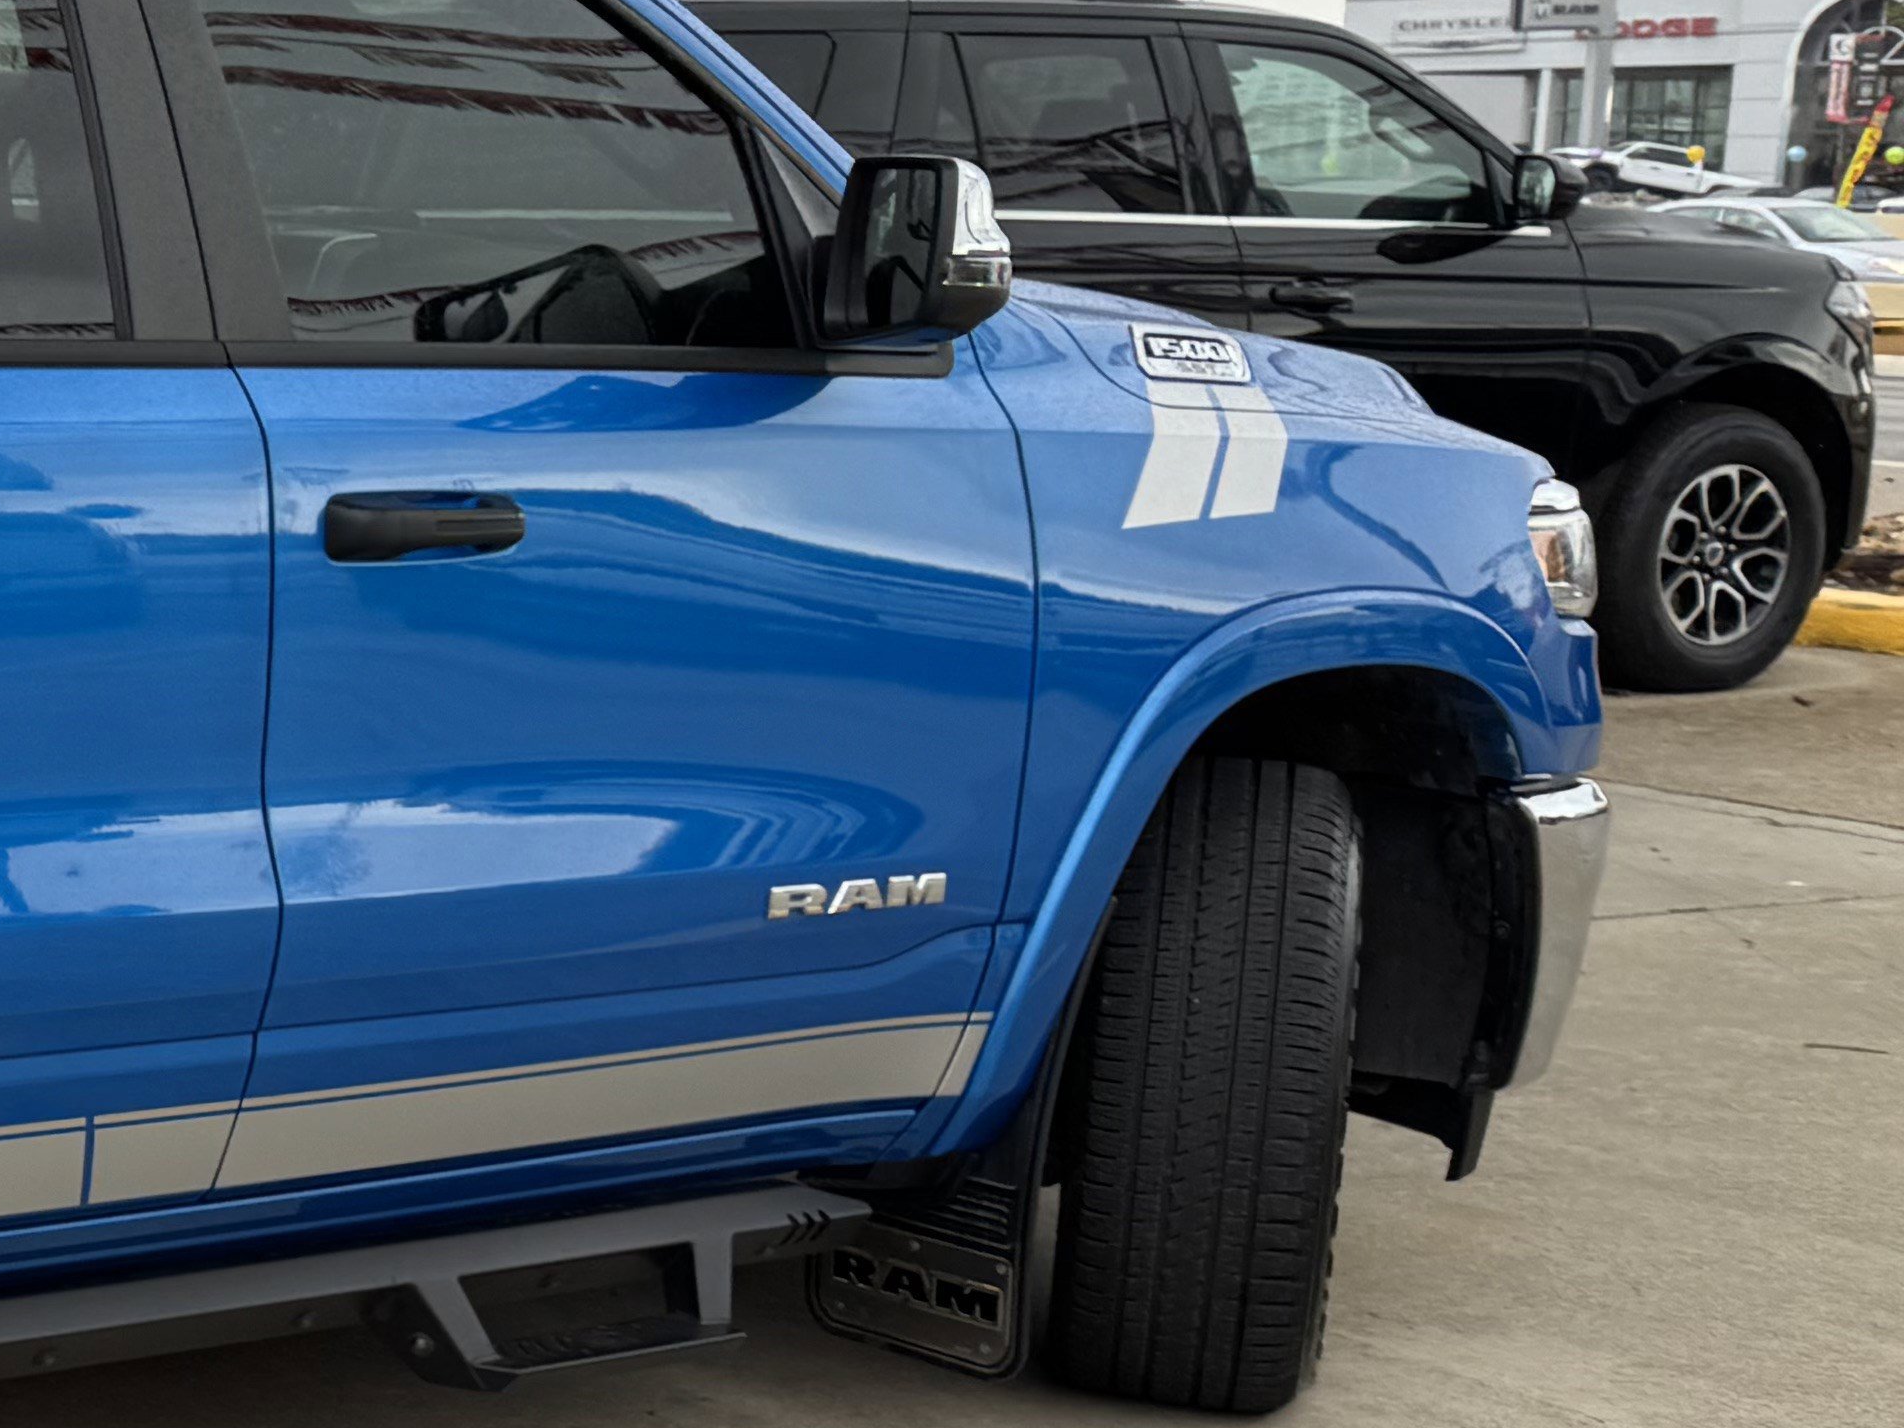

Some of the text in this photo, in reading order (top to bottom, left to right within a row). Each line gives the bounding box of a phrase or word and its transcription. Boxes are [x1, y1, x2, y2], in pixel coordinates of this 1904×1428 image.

[1398, 17, 1512, 31] CHRYSLE
[767, 872, 947, 920] RAM
[832, 1247, 1002, 1329] RAM
